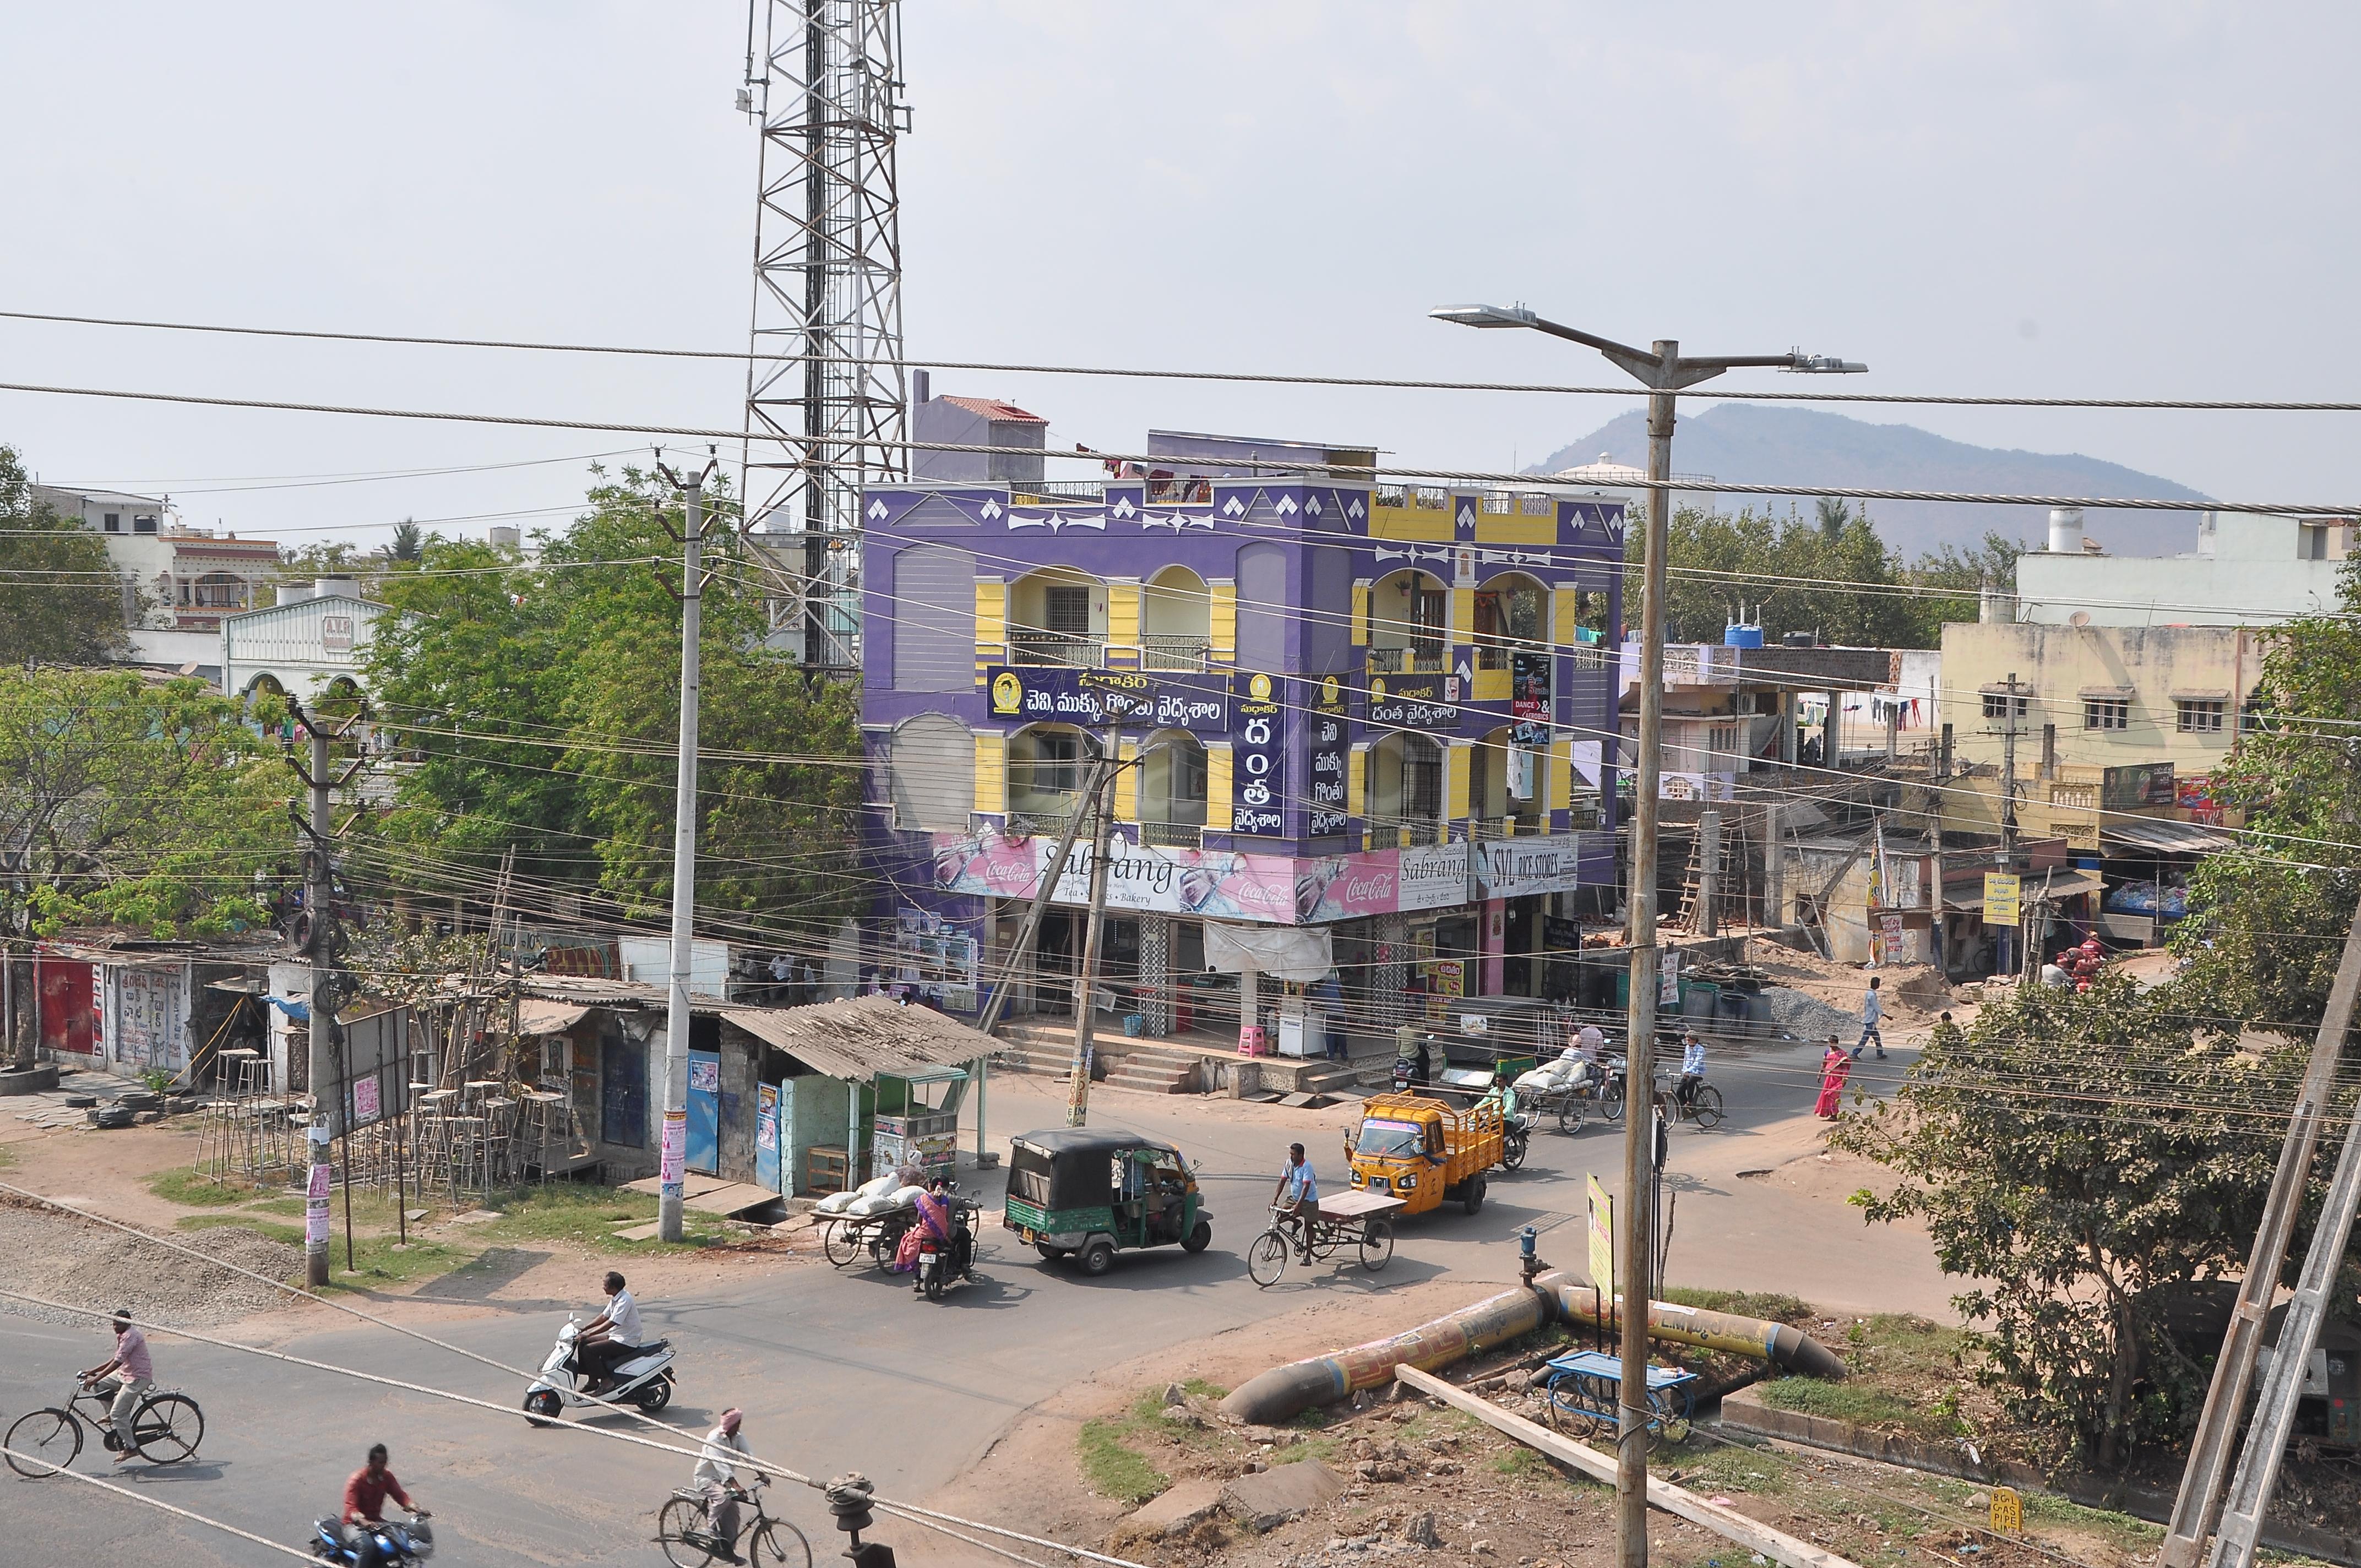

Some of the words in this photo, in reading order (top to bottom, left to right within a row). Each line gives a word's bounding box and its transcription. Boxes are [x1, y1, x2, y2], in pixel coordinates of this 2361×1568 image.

[1157, 694, 1221, 726] వైద్యశాల
[1372, 705, 1403, 721] దంత
[1407, 704, 1457, 725] వైద్యశాల
[1541, 700, 1549, 714] &
[1234, 808, 1281, 833] వైద్యశాల
[1041, 845, 1173, 894] Sabang
[1401, 853, 1466, 884] Sabrang
[1494, 848, 1515, 888] SVL
[1518, 855, 1533, 881] RICE
[1535, 853, 1558, 879] STORES
[1063, 888, 1078, 896] Tea
[1120, 892, 1151, 906] Bakery
[1994, 1493, 2017, 1505] BGL
[1993, 1504, 2016, 1516] GAS
[1994, 1513, 2016, 1525] PIPE
[1994, 1522, 2017, 1533] LIN
